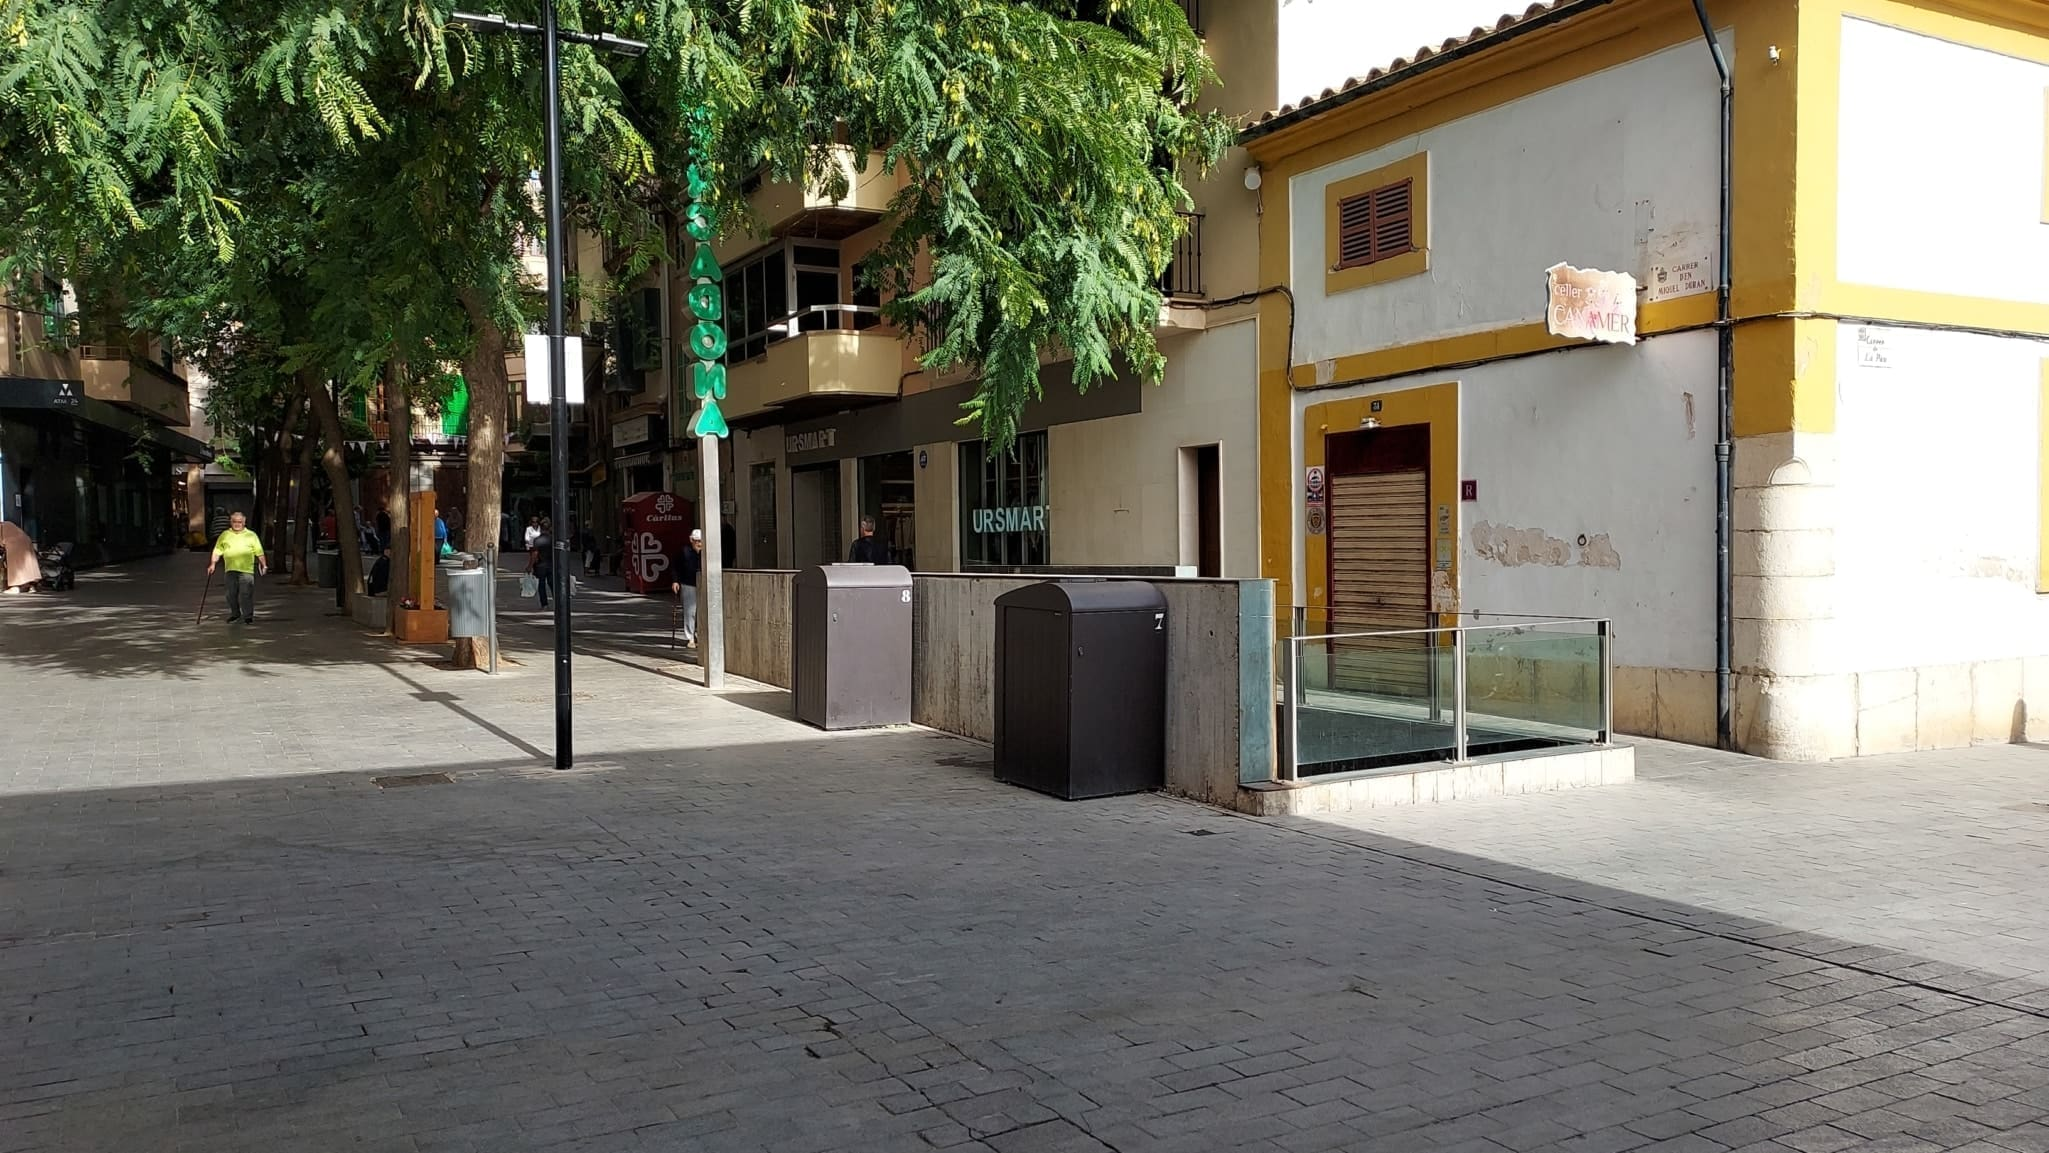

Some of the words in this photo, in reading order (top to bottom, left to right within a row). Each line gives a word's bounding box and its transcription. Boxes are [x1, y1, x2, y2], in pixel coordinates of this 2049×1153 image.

[1671, 261, 1699, 272] CARRER
[786, 428, 837, 453] URSMART
[1465, 484, 1473, 497] R
[972, 504, 1049, 533] URSMAR
[901, 589, 911, 603] 8
[1154, 613, 1164, 630] 7
